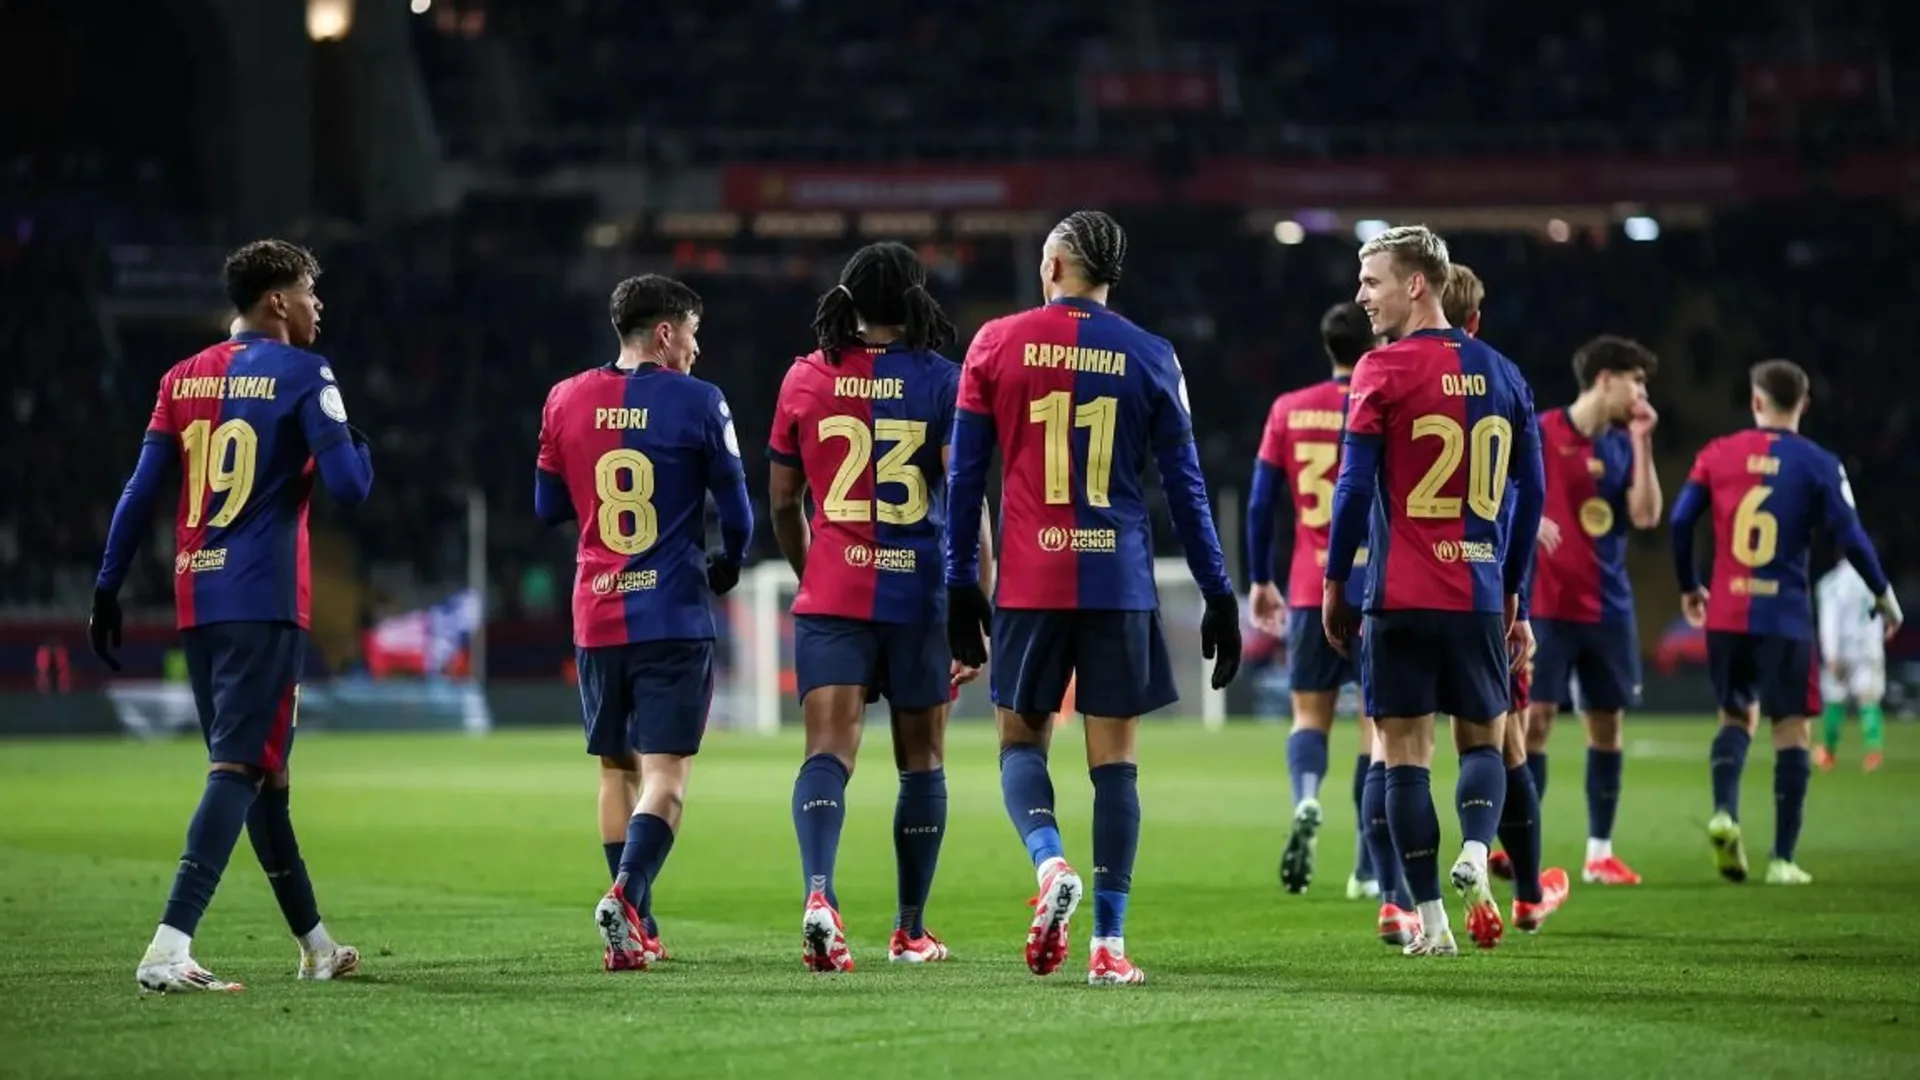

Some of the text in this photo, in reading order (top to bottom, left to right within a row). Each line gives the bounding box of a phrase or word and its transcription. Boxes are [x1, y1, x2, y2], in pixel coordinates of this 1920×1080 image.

[172, 376, 276, 400] LAMINE YAMAL
[834, 376, 904, 399] KOUNDE
[1023, 343, 1126, 376] RAPHINHA
[1441, 374, 1486, 396] OLMO
[595, 408, 648, 430] PEDRI
[180, 418, 258, 528] 19
[818, 414, 929, 525] 23
[1029, 391, 1118, 508] 11
[1406, 414, 1513, 521] 20
[594, 448, 658, 555] 8
[1731, 485, 1779, 568] 6
[1070, 538, 1116, 548] ACNUR
